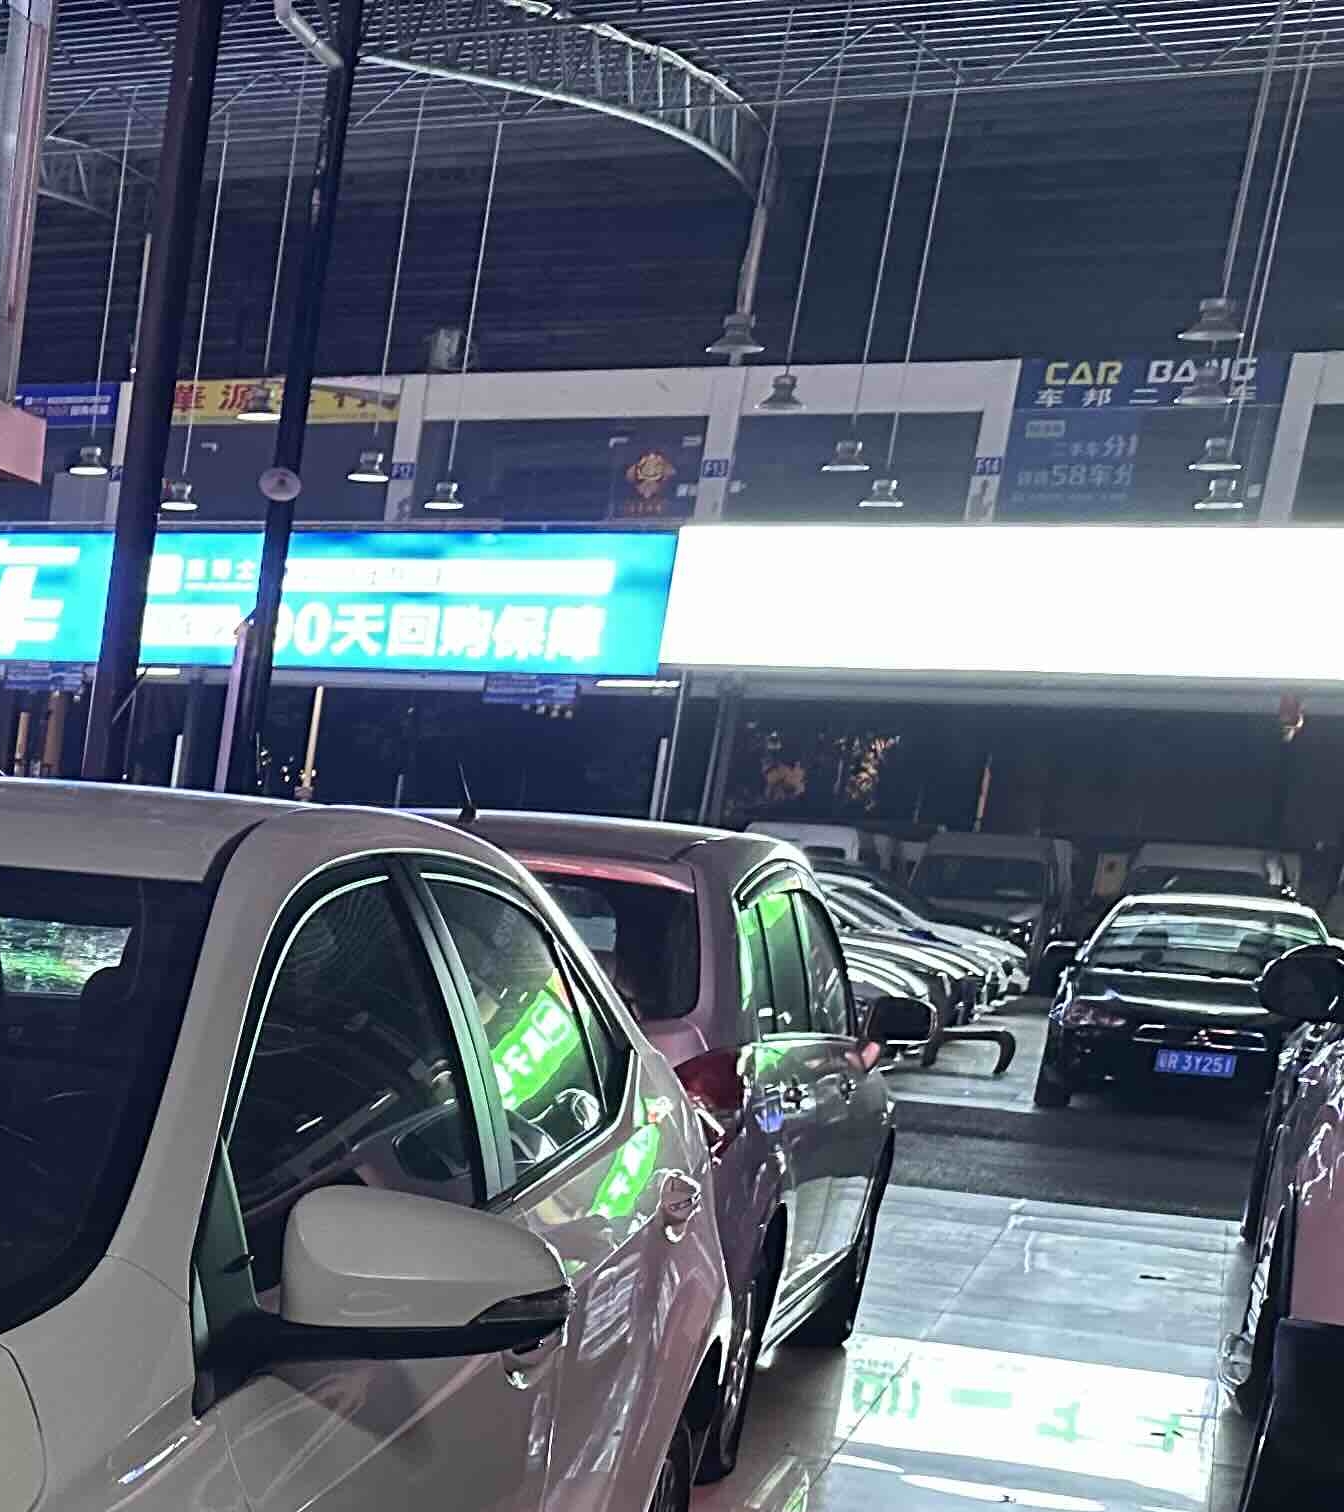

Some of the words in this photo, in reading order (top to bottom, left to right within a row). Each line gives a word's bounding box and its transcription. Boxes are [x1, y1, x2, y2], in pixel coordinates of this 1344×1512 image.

[1044, 361, 1123, 385] CAR
[1035, 387, 1257, 408] 车邦二车
